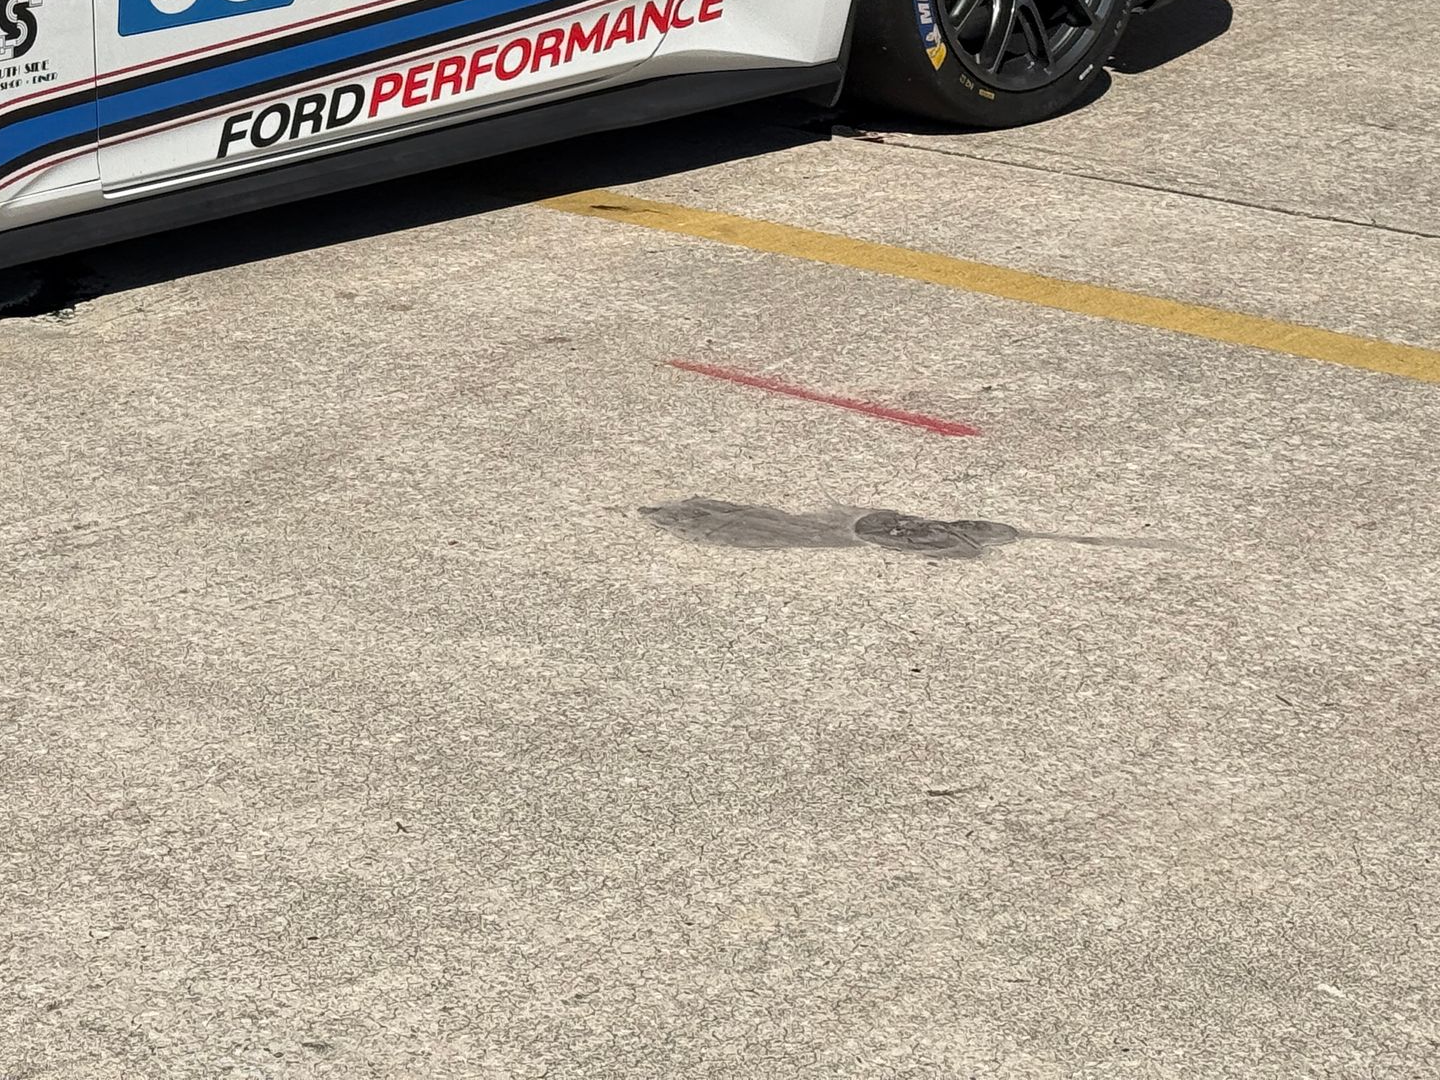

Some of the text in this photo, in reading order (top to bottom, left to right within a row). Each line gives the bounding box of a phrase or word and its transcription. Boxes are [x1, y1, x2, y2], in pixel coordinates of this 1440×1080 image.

[24, 59, 50, 74] SIDE
[0, 79, 23, 91] SHOP
[32, 72, 58, 85] DINER
